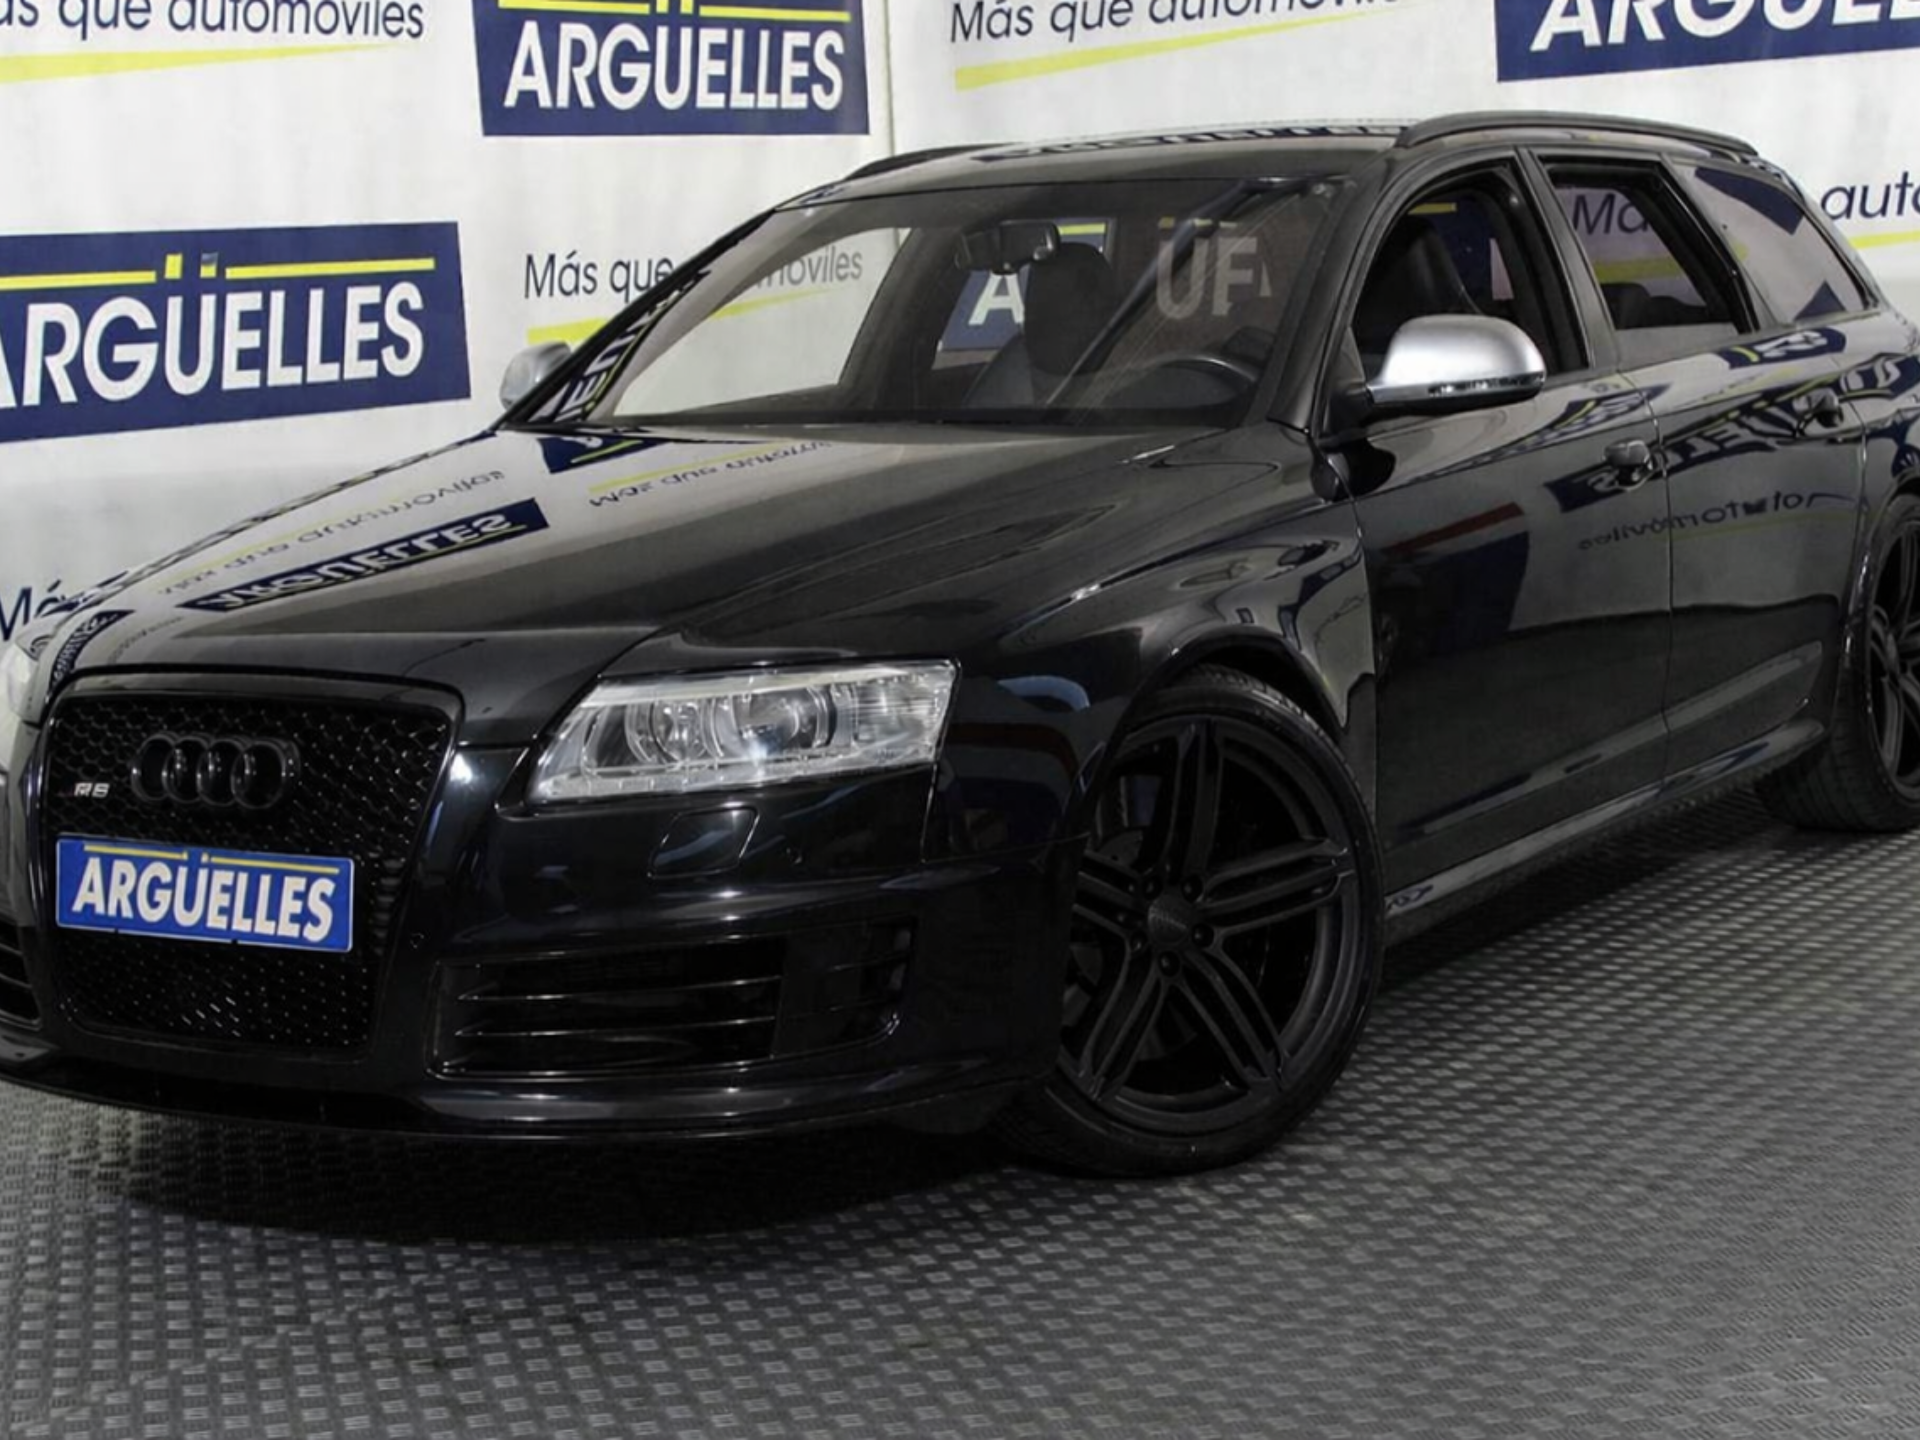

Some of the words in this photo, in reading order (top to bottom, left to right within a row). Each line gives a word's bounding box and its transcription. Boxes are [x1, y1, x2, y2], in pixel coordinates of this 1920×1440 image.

[58, 0, 151, 41] que
[1045, 0, 1133, 43] que
[524, 249, 598, 299] Más
[0, 252, 425, 408] RGÜELLES
[72, 852, 336, 943] ARGÜELLES
